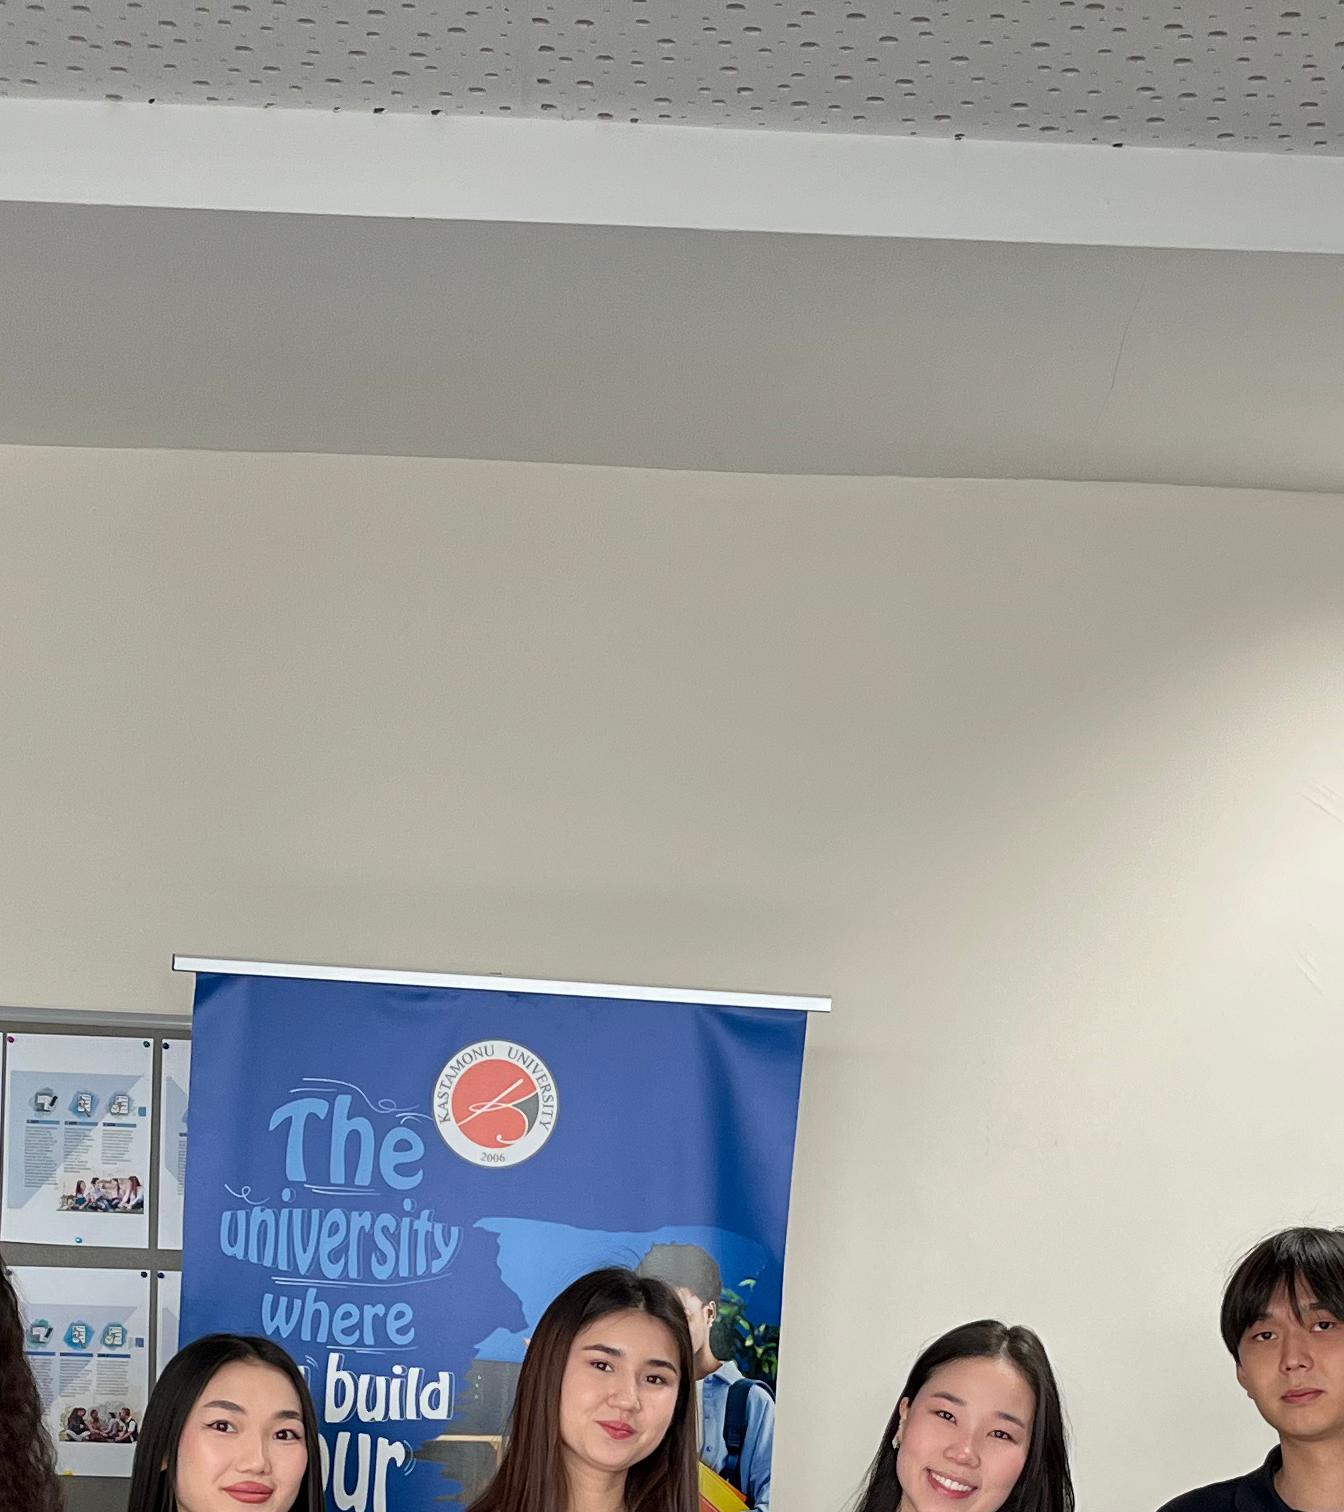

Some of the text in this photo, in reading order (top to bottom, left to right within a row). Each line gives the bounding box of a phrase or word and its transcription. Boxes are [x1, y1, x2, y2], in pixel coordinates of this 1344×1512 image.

[436, 1044, 554, 1131] KASTAMONU UNIVERSITY
[268, 1094, 425, 1190] The
[480, 1152, 506, 1163] 2006
[220, 1187, 463, 1280] university
[262, 1288, 415, 1346] where
[324, 1352, 455, 1423] build
